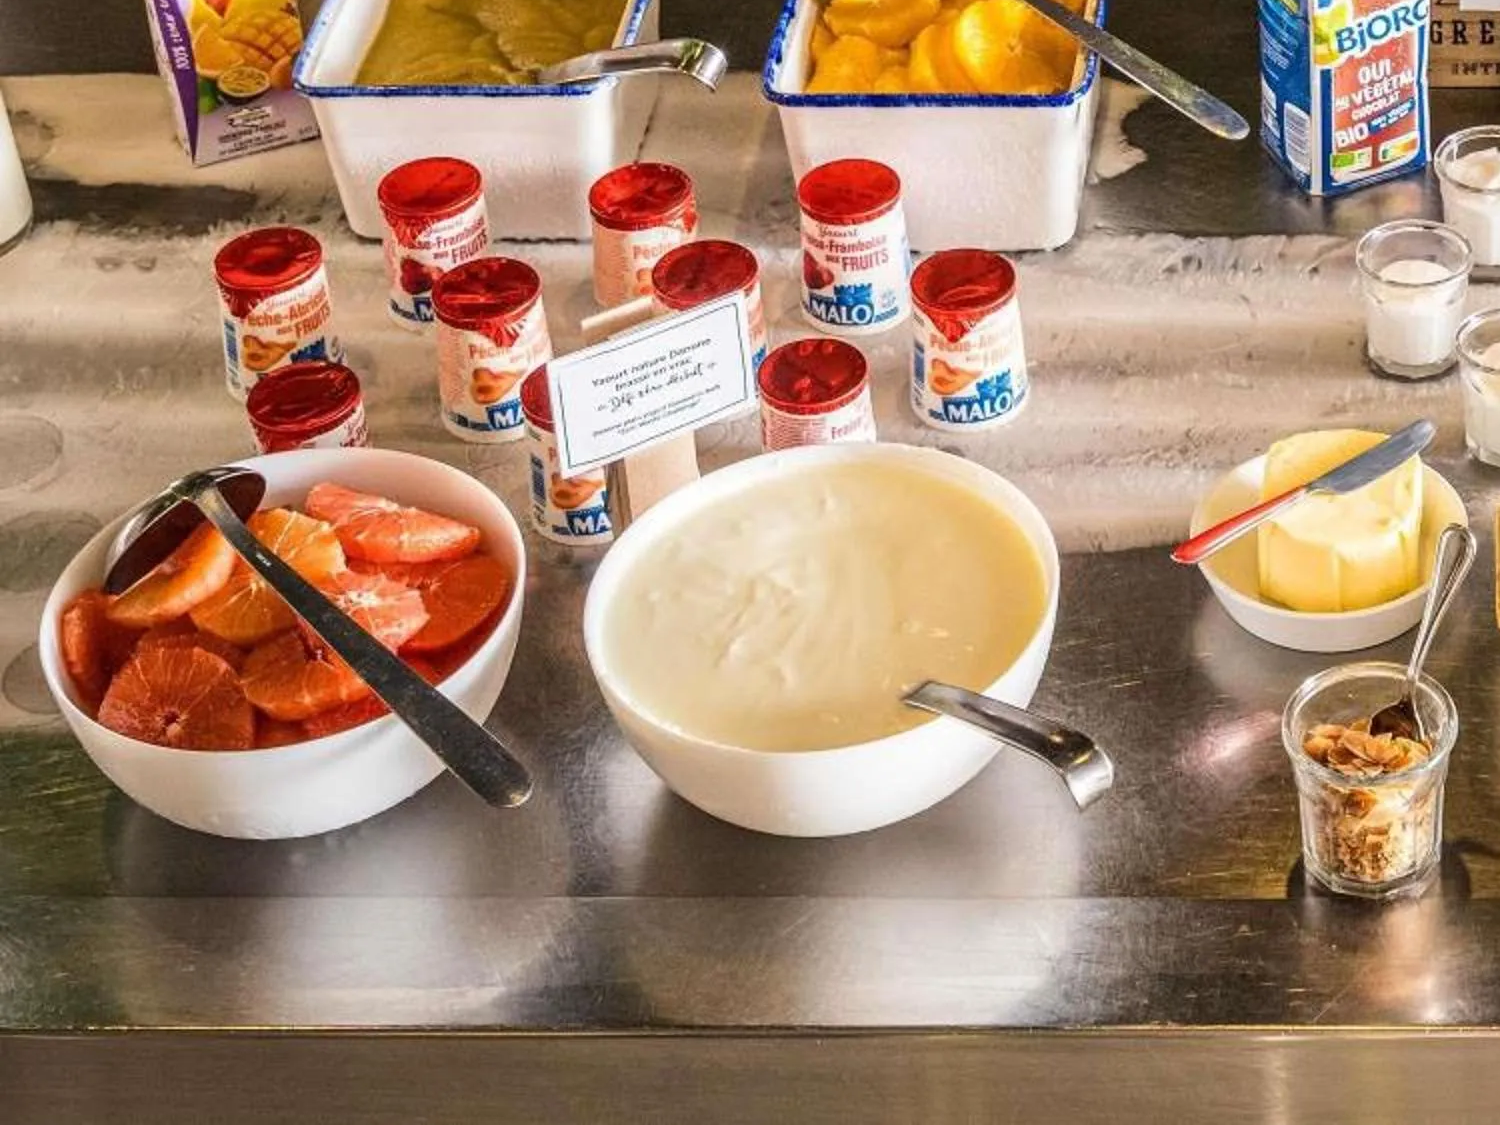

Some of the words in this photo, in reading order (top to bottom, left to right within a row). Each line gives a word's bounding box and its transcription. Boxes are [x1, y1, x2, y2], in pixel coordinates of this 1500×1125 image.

[1358, 58, 1392, 84] OUI
[1335, 123, 1369, 147] BIO
[451, 229, 488, 263] FRUITS
[841, 248, 889, 272] FRUITS
[810, 298, 872, 323] MALO
[946, 391, 1011, 421] MALO
